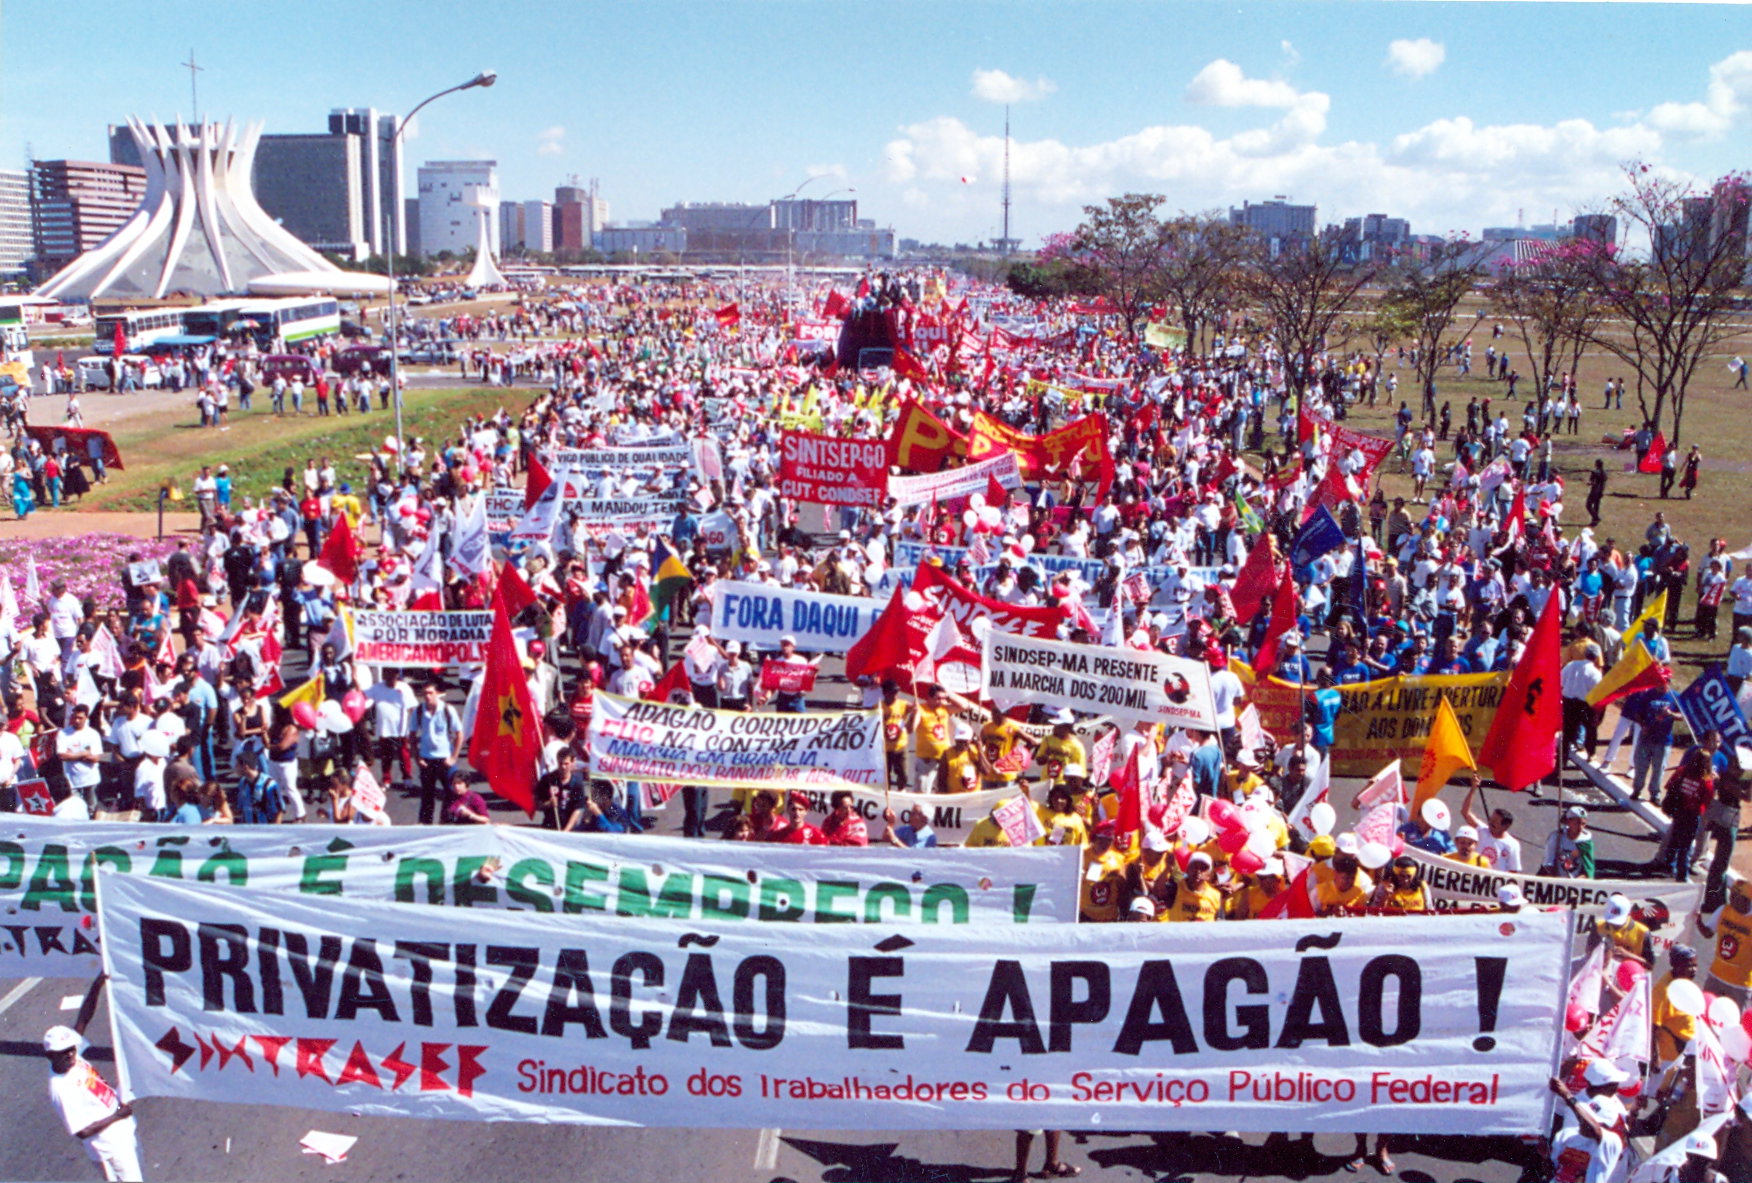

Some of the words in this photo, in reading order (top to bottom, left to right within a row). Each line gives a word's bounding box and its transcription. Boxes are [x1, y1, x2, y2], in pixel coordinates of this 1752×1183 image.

[800, 325, 843, 341] FOR
[784, 435, 886, 469] SINTSEP-GO
[796, 466, 844, 482] FILIADO
[591, 501, 648, 514] MANDOU
[449, 614, 463, 627] DE
[722, 594, 784, 630] FORA
[792, 600, 859, 638] DAQUI
[373, 628, 409, 642] POR
[414, 628, 486, 642] MORADIA
[994, 645, 1089, 674] SINDSEP-MA
[1094, 657, 1158, 683] PRESENTE
[989, 670, 1005, 688] NA
[1010, 672, 1065, 696] MARCHA
[1070, 680, 1096, 700] DOS
[1100, 685, 1123, 705] 200
[1123, 688, 1149, 711] MIL
[1402, 713, 1473, 740] DOMOS
[606, 739, 688, 761] MARCHA
[660, 730, 697, 750] NA
[705, 735, 800, 753] CONTRA
[1416, 860, 1517, 898] UEREMO
[1523, 879, 1624, 906] EMPREG
[139, 917, 787, 1051] PRIVATIZAÇÃO
[847, 934, 916, 1050] É
[964, 931, 1422, 1055] APAGÃO
[1472, 956, 1510, 1053] !
[516, 1058, 668, 1097] Sindicato
[687, 1067, 743, 1098] dos
[1014, 1074, 1051, 1103] do
[1071, 1071, 1209, 1108] Serviço
[1228, 1068, 1356, 1104] Público
[1371, 1071, 1500, 1106] Federal
